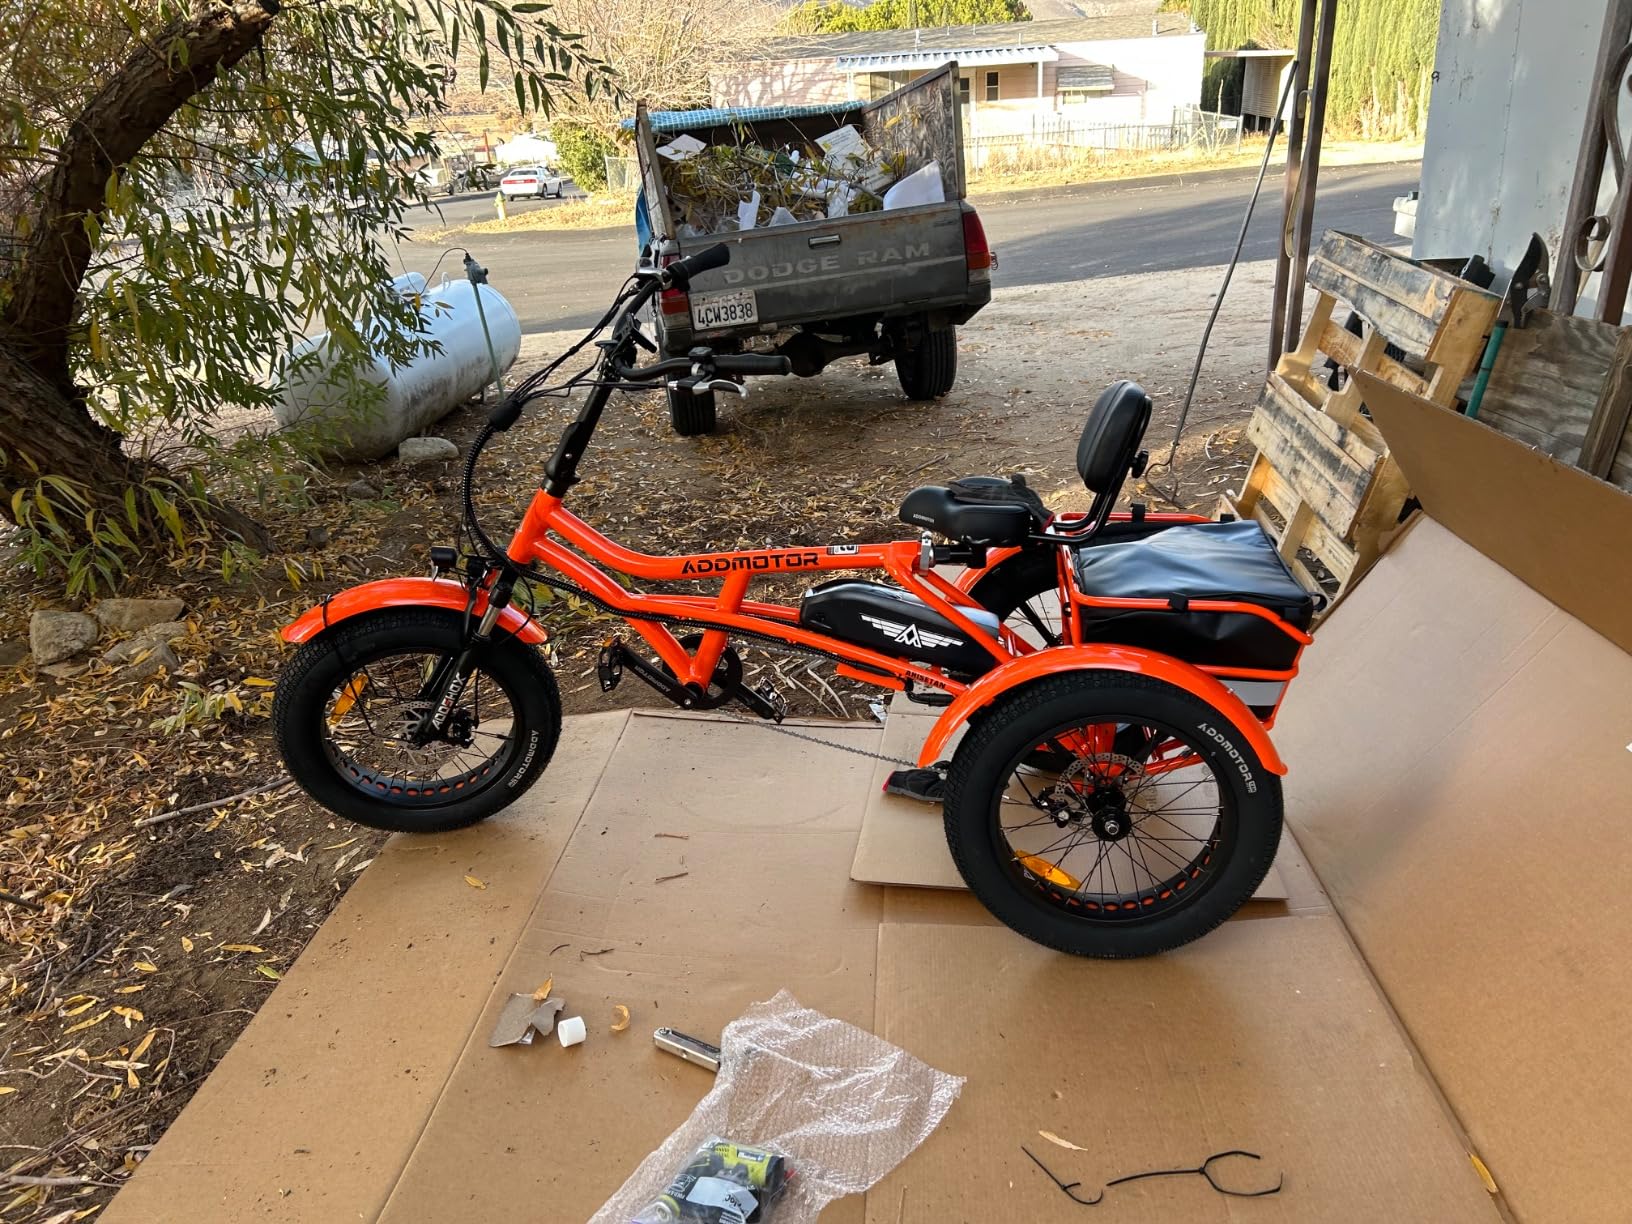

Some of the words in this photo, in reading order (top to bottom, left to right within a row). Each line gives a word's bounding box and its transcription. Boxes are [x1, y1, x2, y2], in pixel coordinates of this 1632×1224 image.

[724, 255, 841, 284] DODGE
[857, 243, 930, 266] RAM
[697, 303, 753, 324] 4CW3838
[681, 552, 819, 574] ADDMOTOR
[432, 672, 467, 731] ADDSHOX
[513, 730, 540, 784] ADDMOTOR
[1197, 722, 1253, 782] ADDMOTOR
